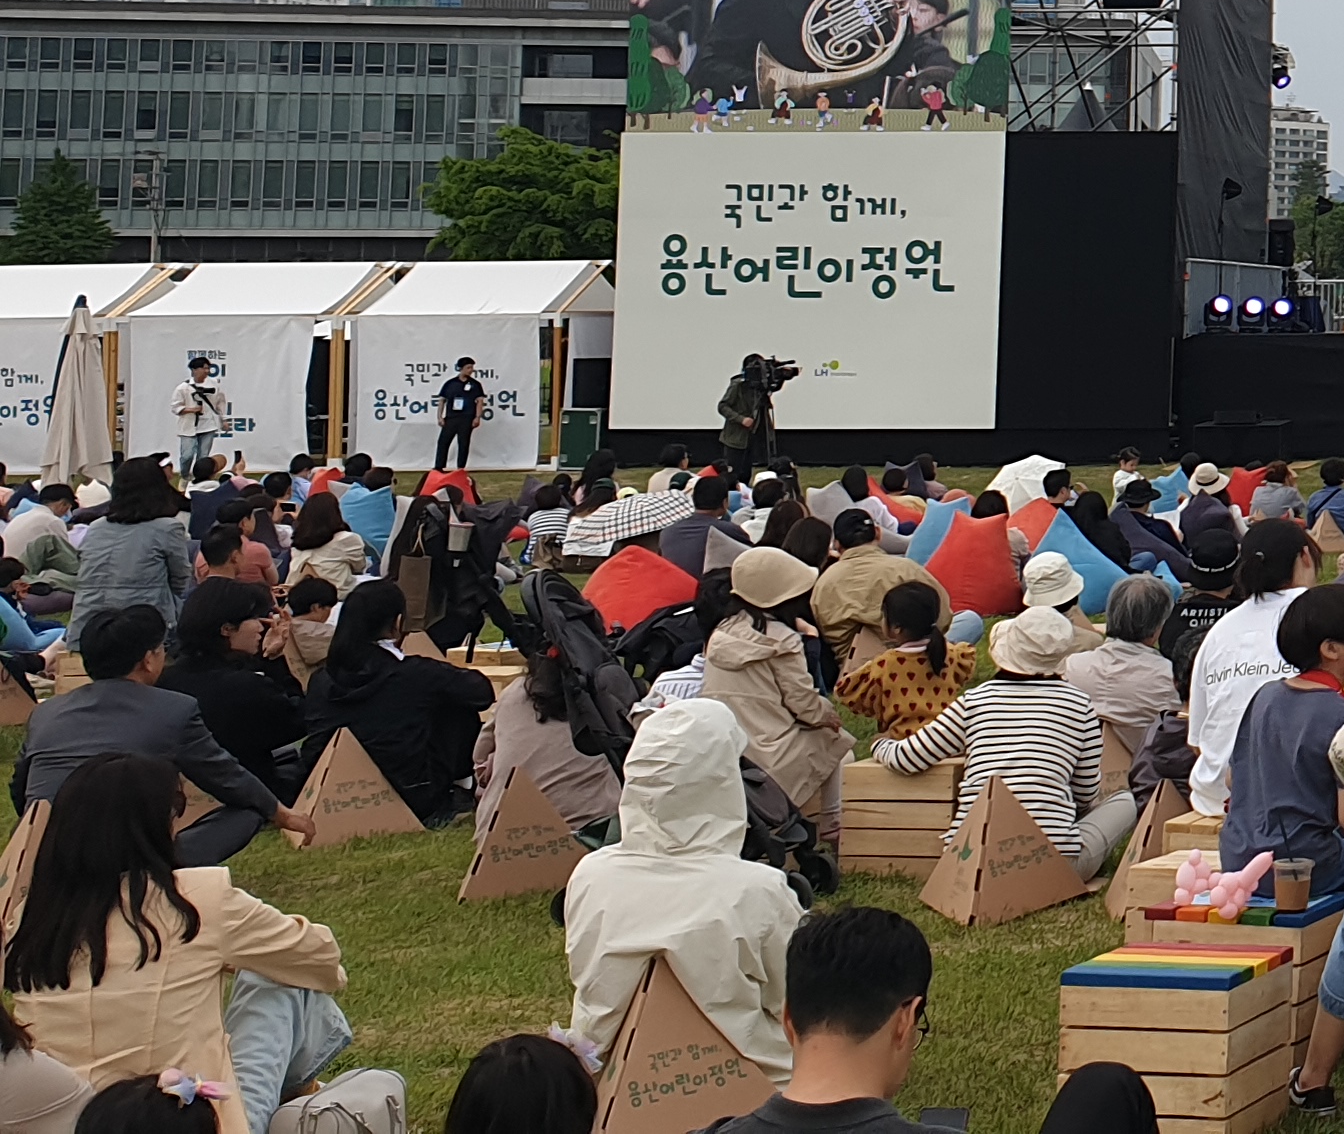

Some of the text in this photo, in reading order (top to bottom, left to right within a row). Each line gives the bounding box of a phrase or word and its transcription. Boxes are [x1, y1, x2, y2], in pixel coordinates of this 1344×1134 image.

[725, 183, 907, 228] 국민과 함께,
[660, 233, 955, 299] 용산어린이정원
[405, 364, 448, 386] 국민과
[1206, 667, 1232, 685] alvin
[1233, 661, 1269, 678] Klein
[648, 1048, 682, 1073] 국민과
[628, 1057, 747, 1107] 용산어린이정원
